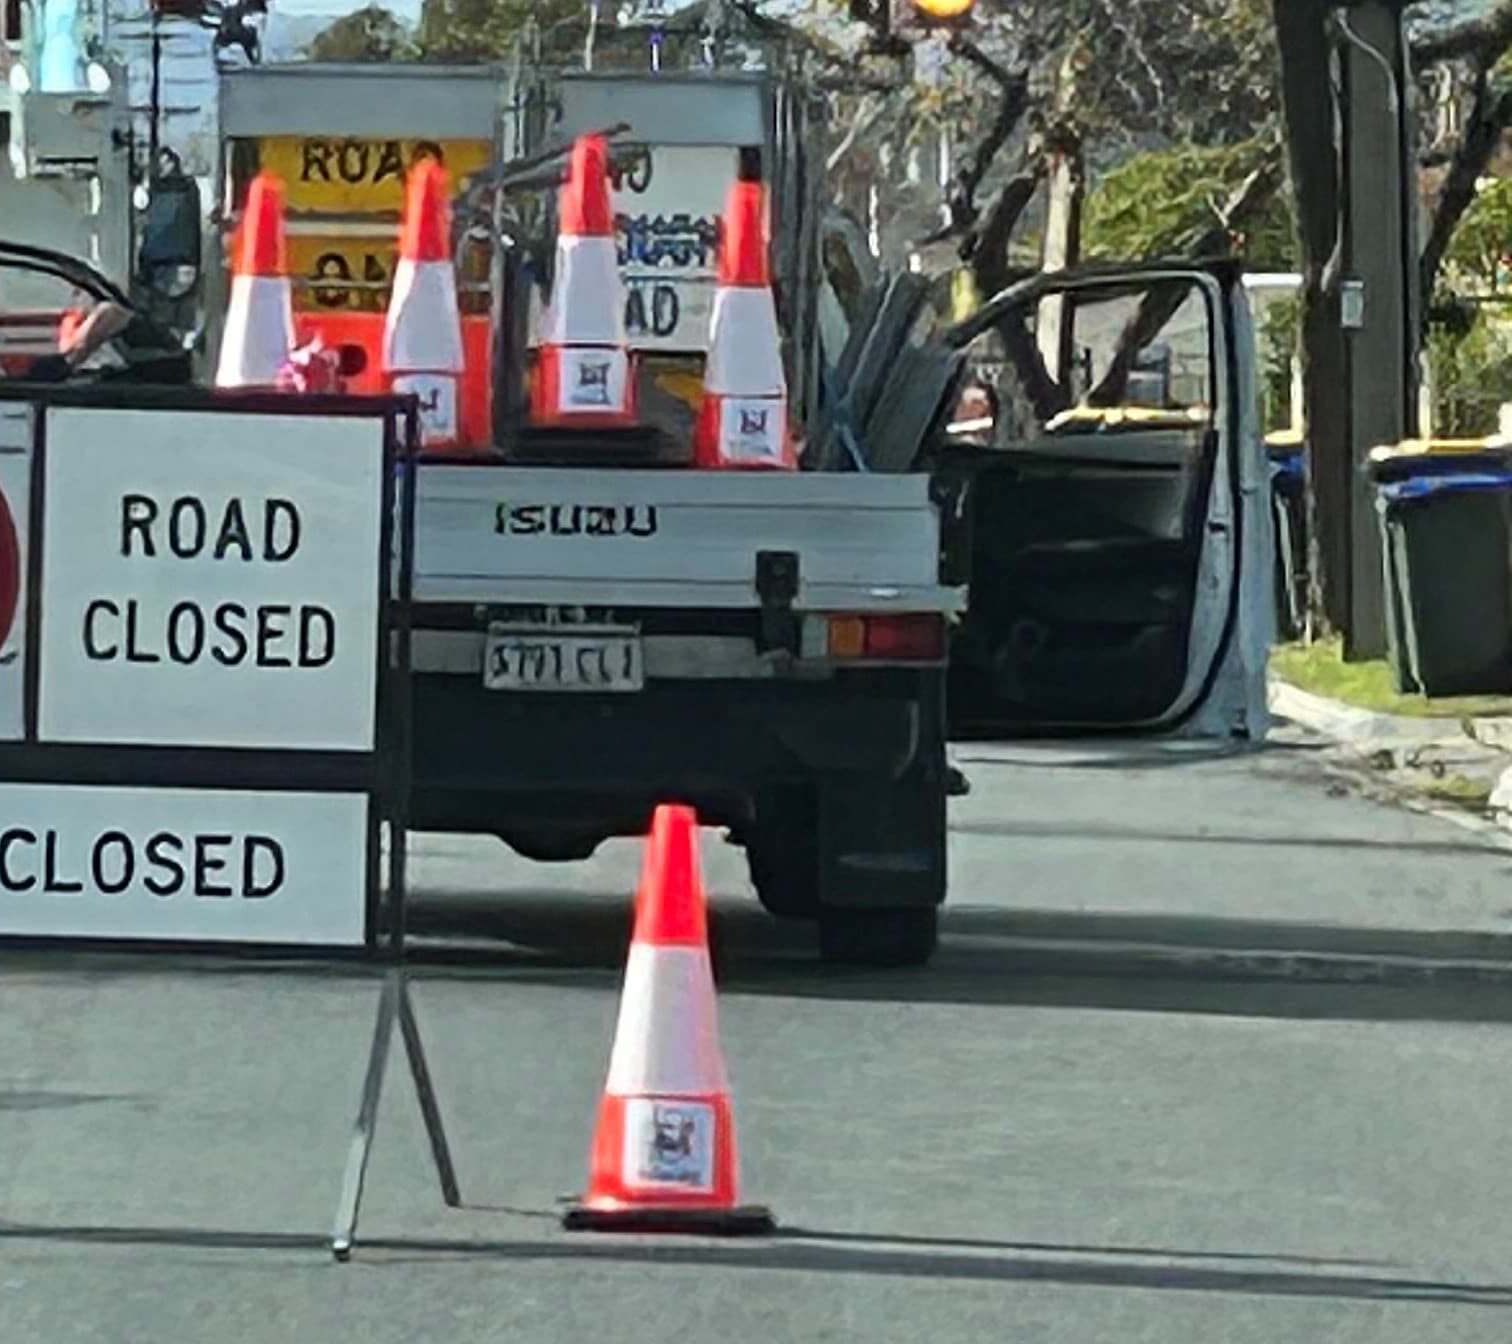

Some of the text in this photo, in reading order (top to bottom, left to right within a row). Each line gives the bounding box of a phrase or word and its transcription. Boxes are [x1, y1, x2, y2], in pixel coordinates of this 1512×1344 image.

[120, 494, 302, 562] ROAD
[494, 502, 658, 537] ISUZU
[82, 599, 336, 669] CLOSED
